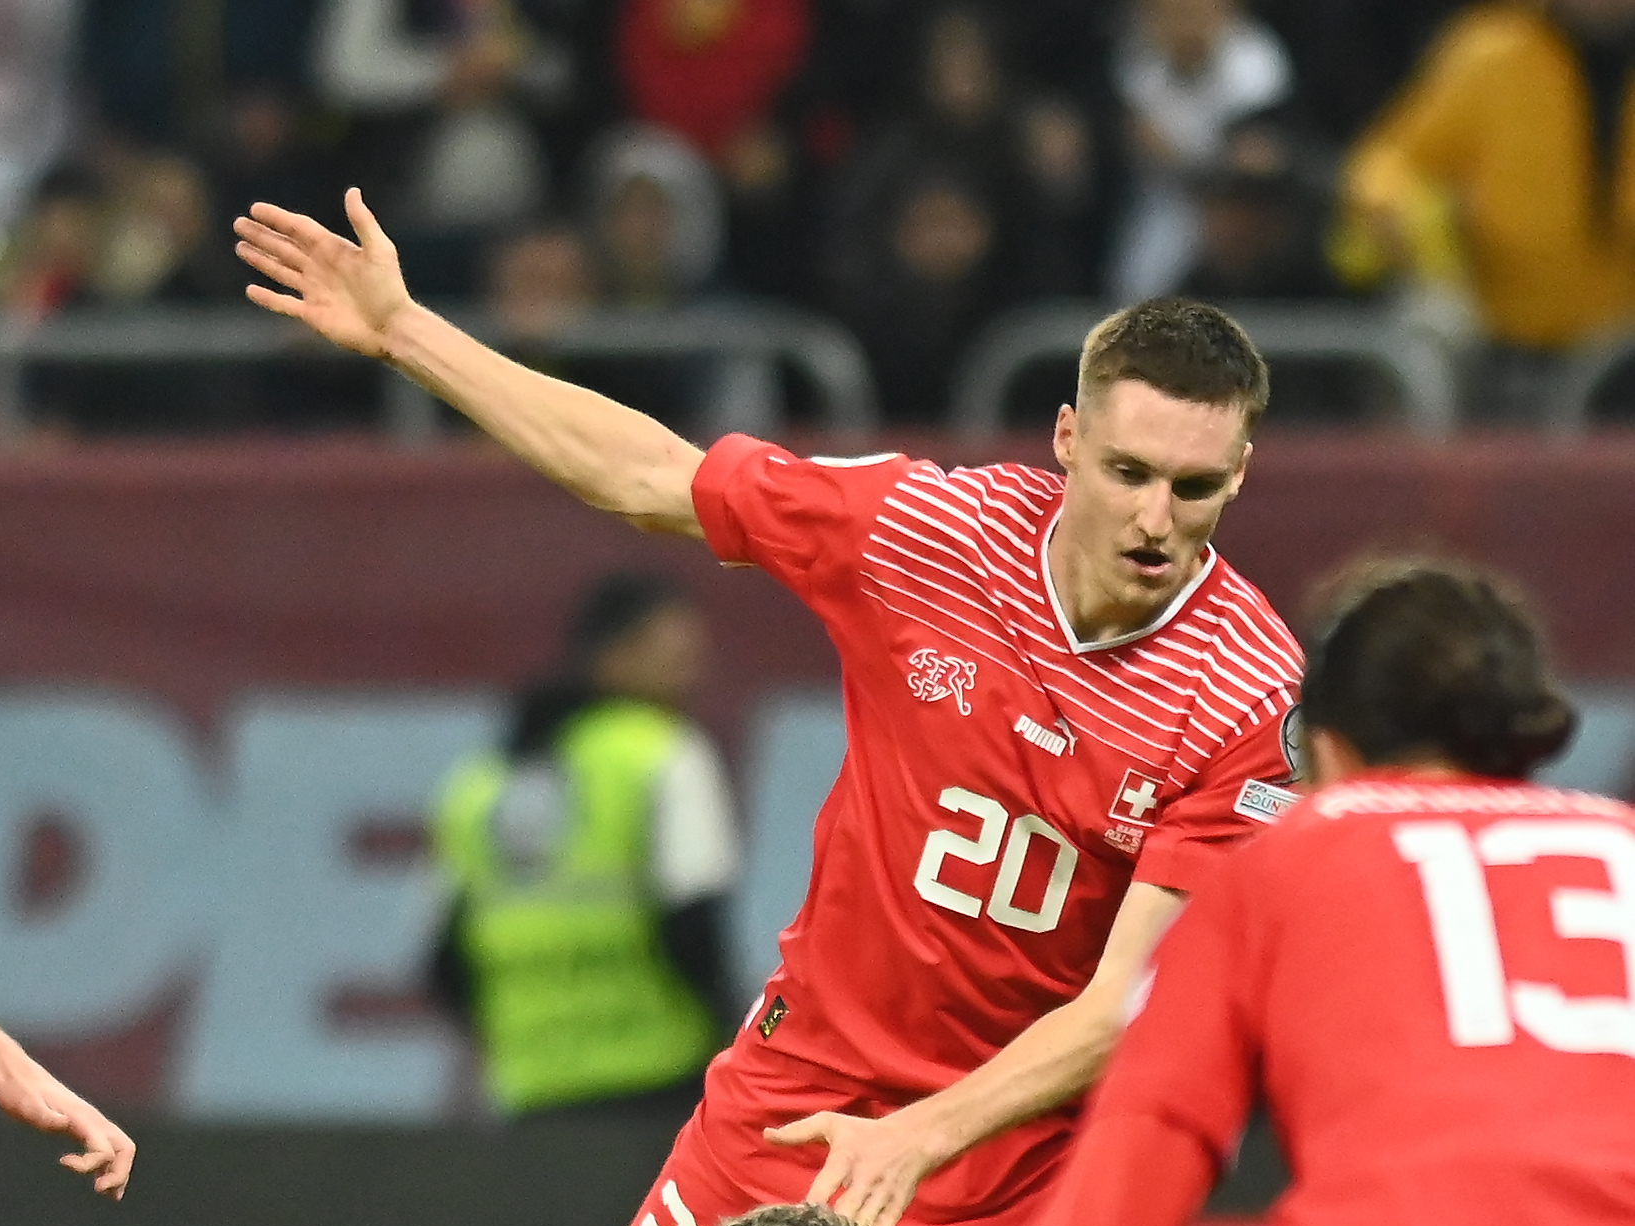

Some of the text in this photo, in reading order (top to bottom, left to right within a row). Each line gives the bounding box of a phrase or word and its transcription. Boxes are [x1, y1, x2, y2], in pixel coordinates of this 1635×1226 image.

[1013, 714, 1067, 757] PUMA
[1242, 790, 1285, 813] FOUN
[913, 786, 1079, 934] 20
[1389, 817, 1635, 1058] 13
